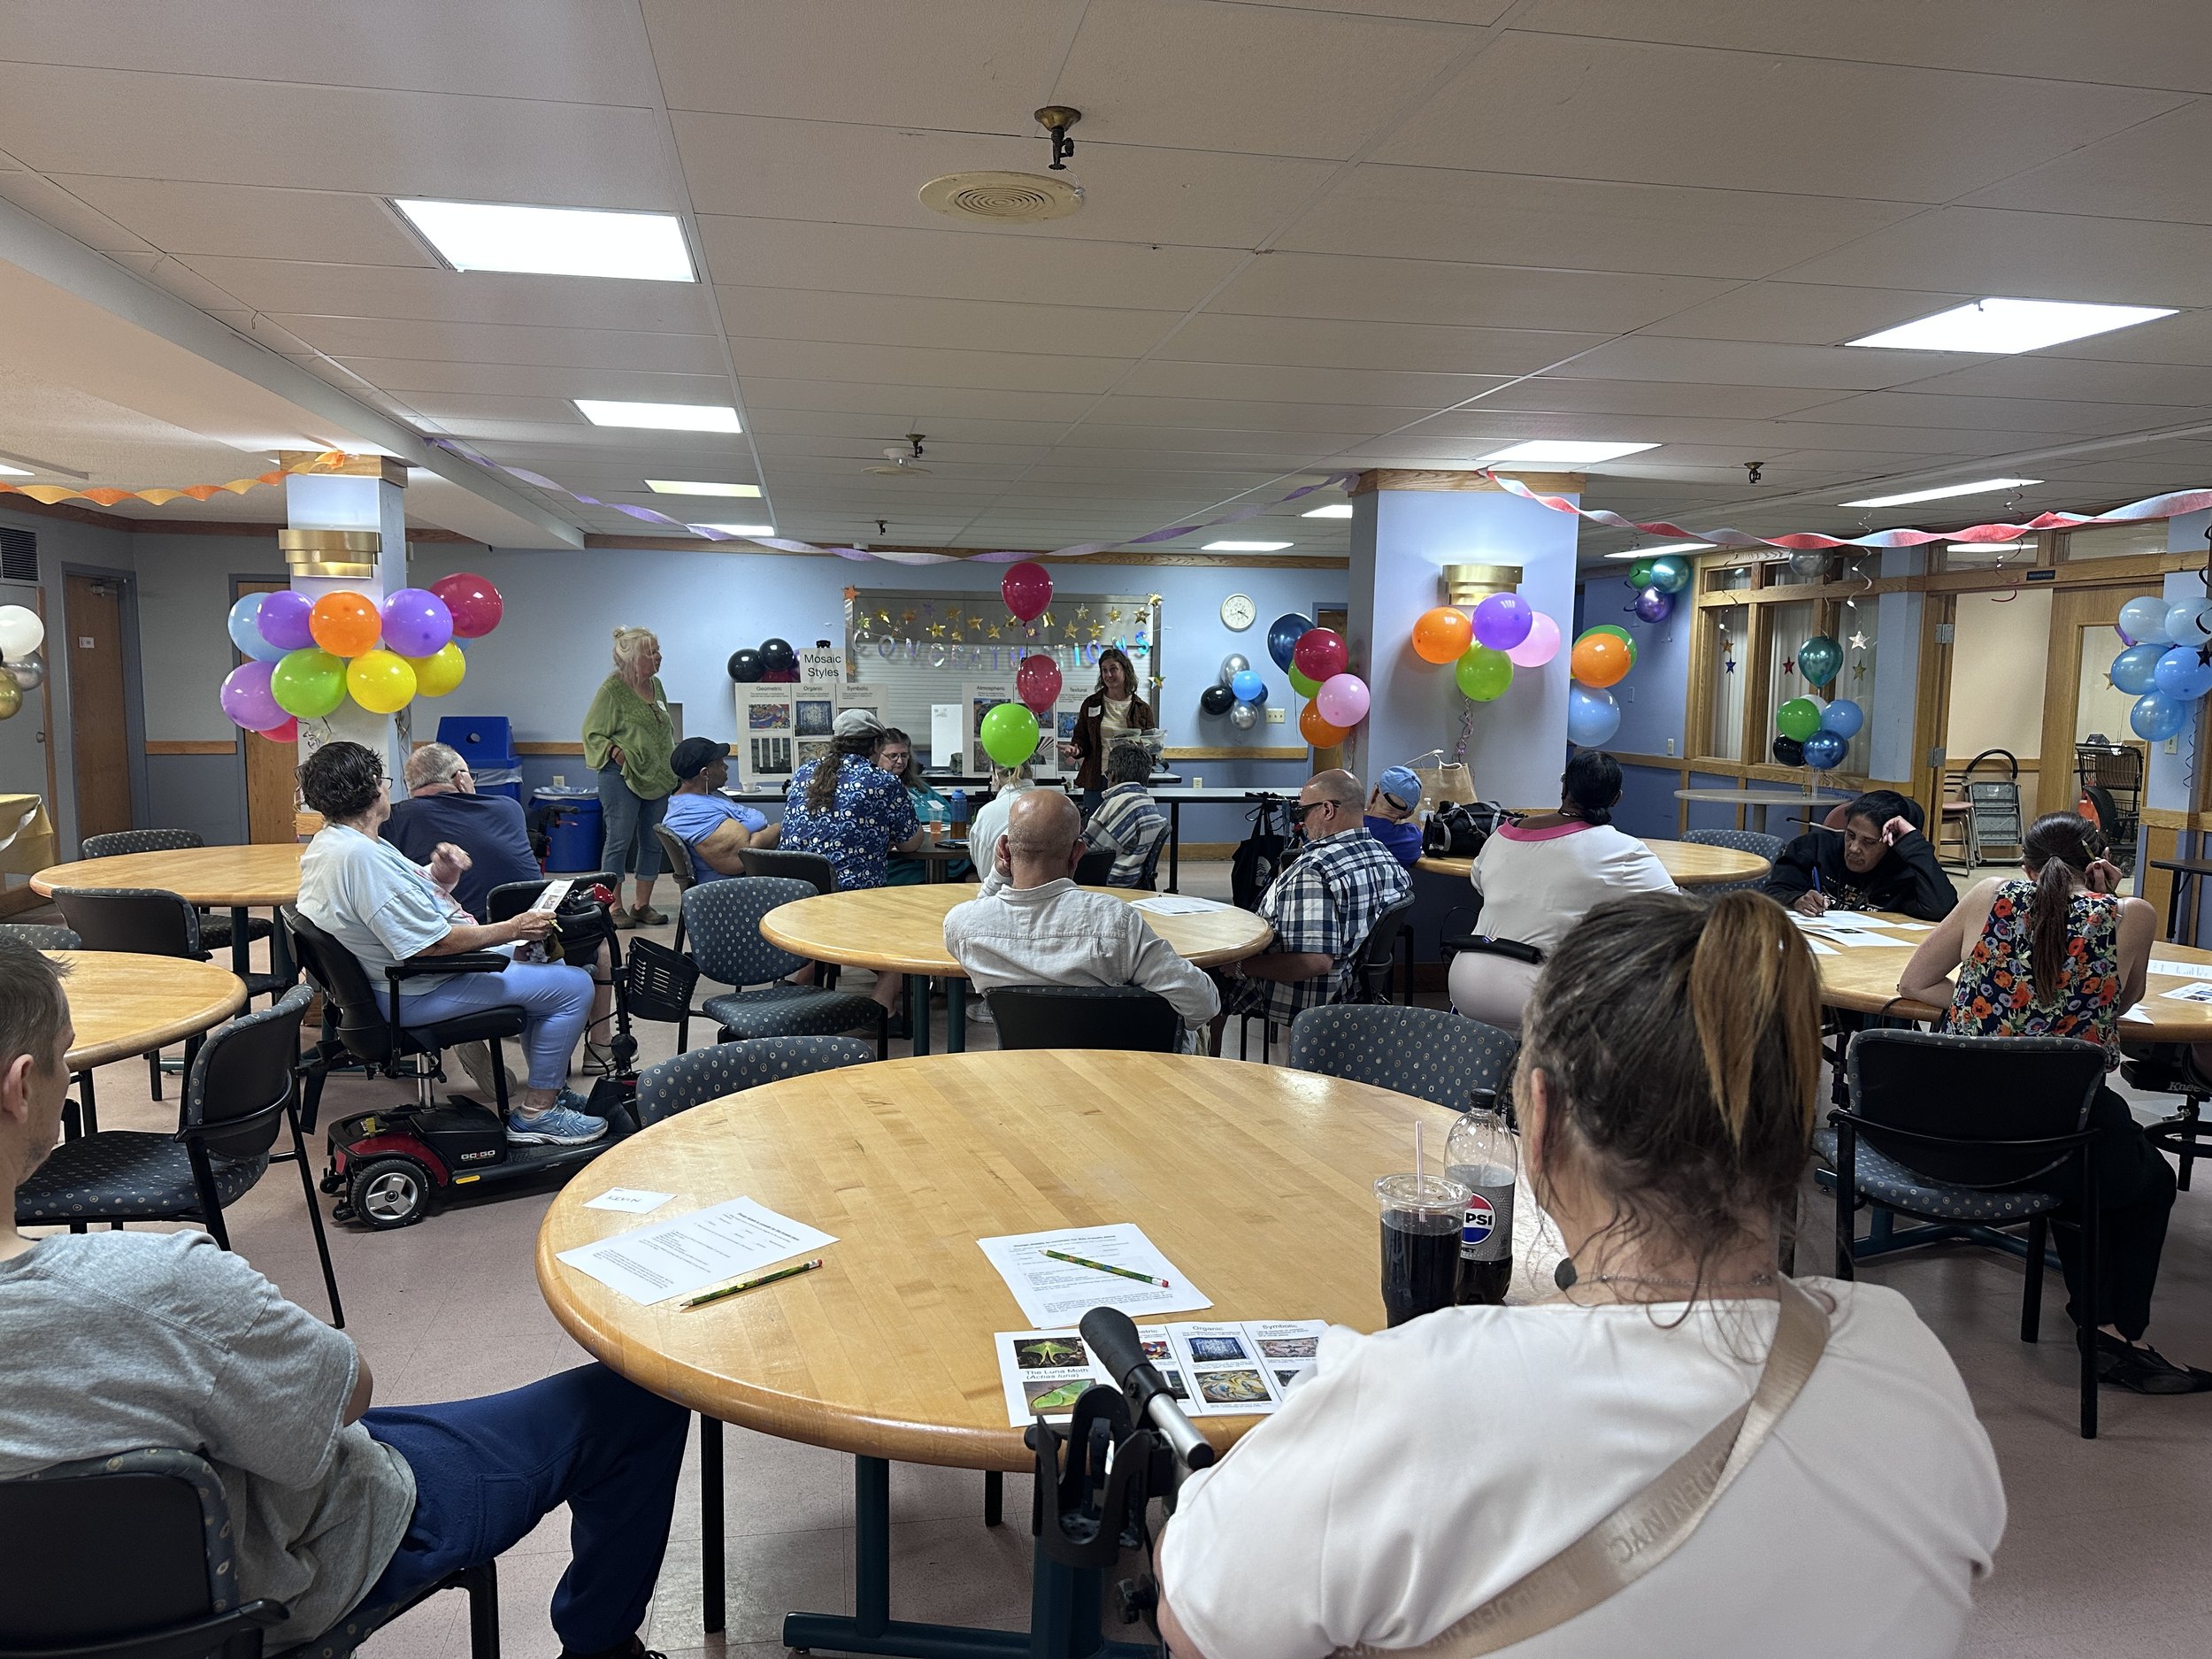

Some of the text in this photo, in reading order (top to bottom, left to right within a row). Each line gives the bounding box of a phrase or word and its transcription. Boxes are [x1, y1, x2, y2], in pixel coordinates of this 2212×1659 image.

[804, 655, 841, 664] Mosaic
[807, 668, 839, 679] Styles
[1465, 1212, 1493, 1225] PSI
